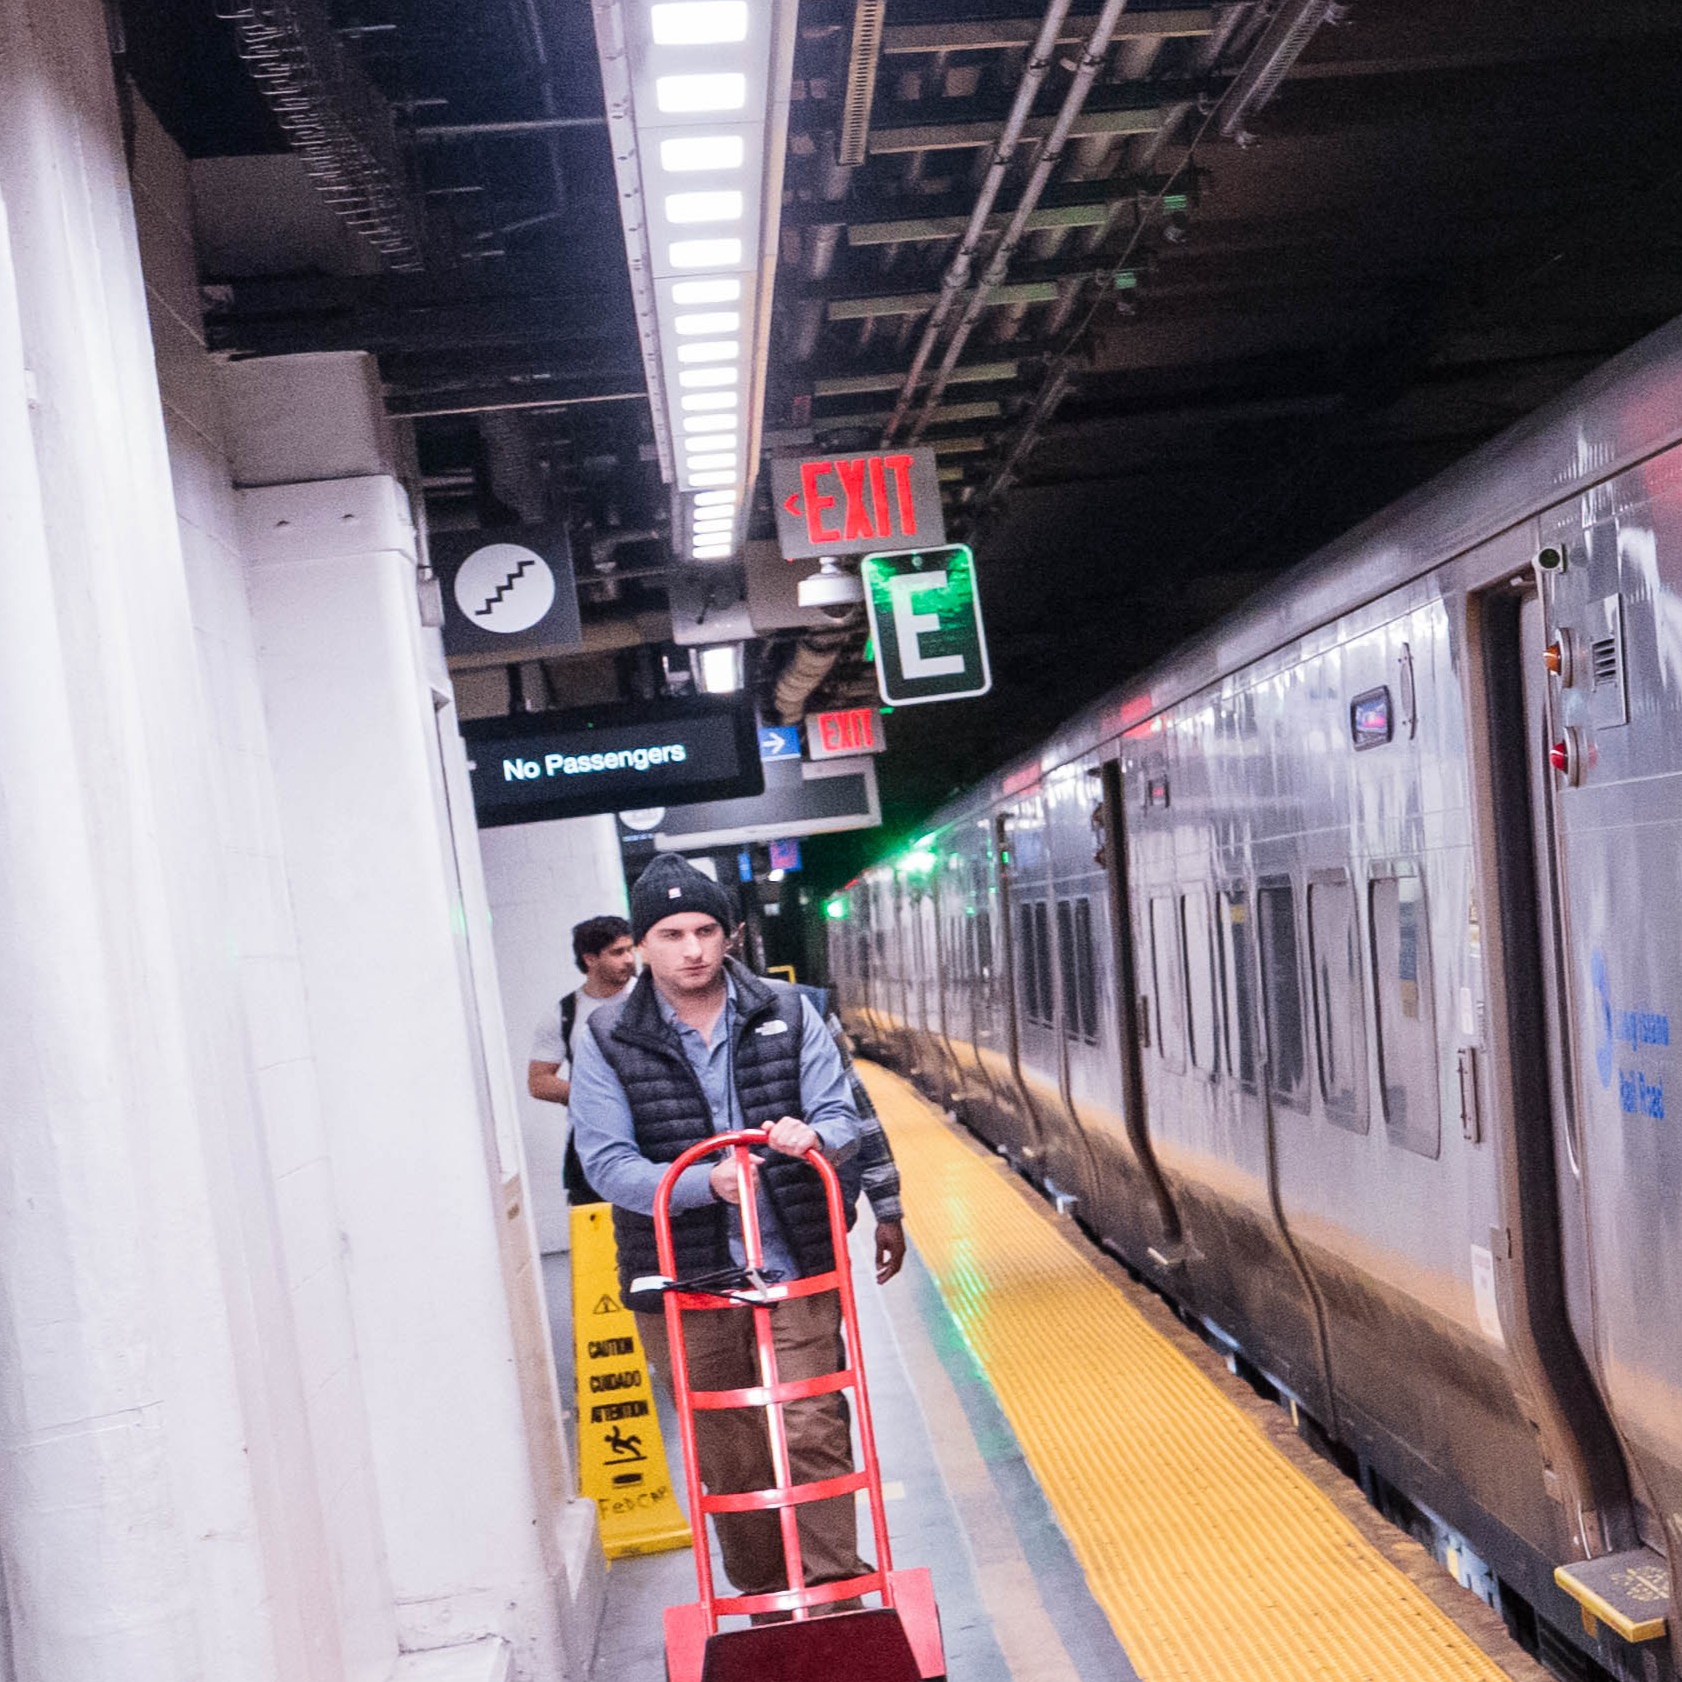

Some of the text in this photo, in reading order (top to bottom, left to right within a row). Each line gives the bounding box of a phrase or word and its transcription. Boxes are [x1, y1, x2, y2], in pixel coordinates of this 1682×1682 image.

[801, 454, 917, 544] EXIT
[889, 570, 966, 679] E
[503, 744, 687, 781] No Passengers
[817, 708, 875, 751] EXIT
